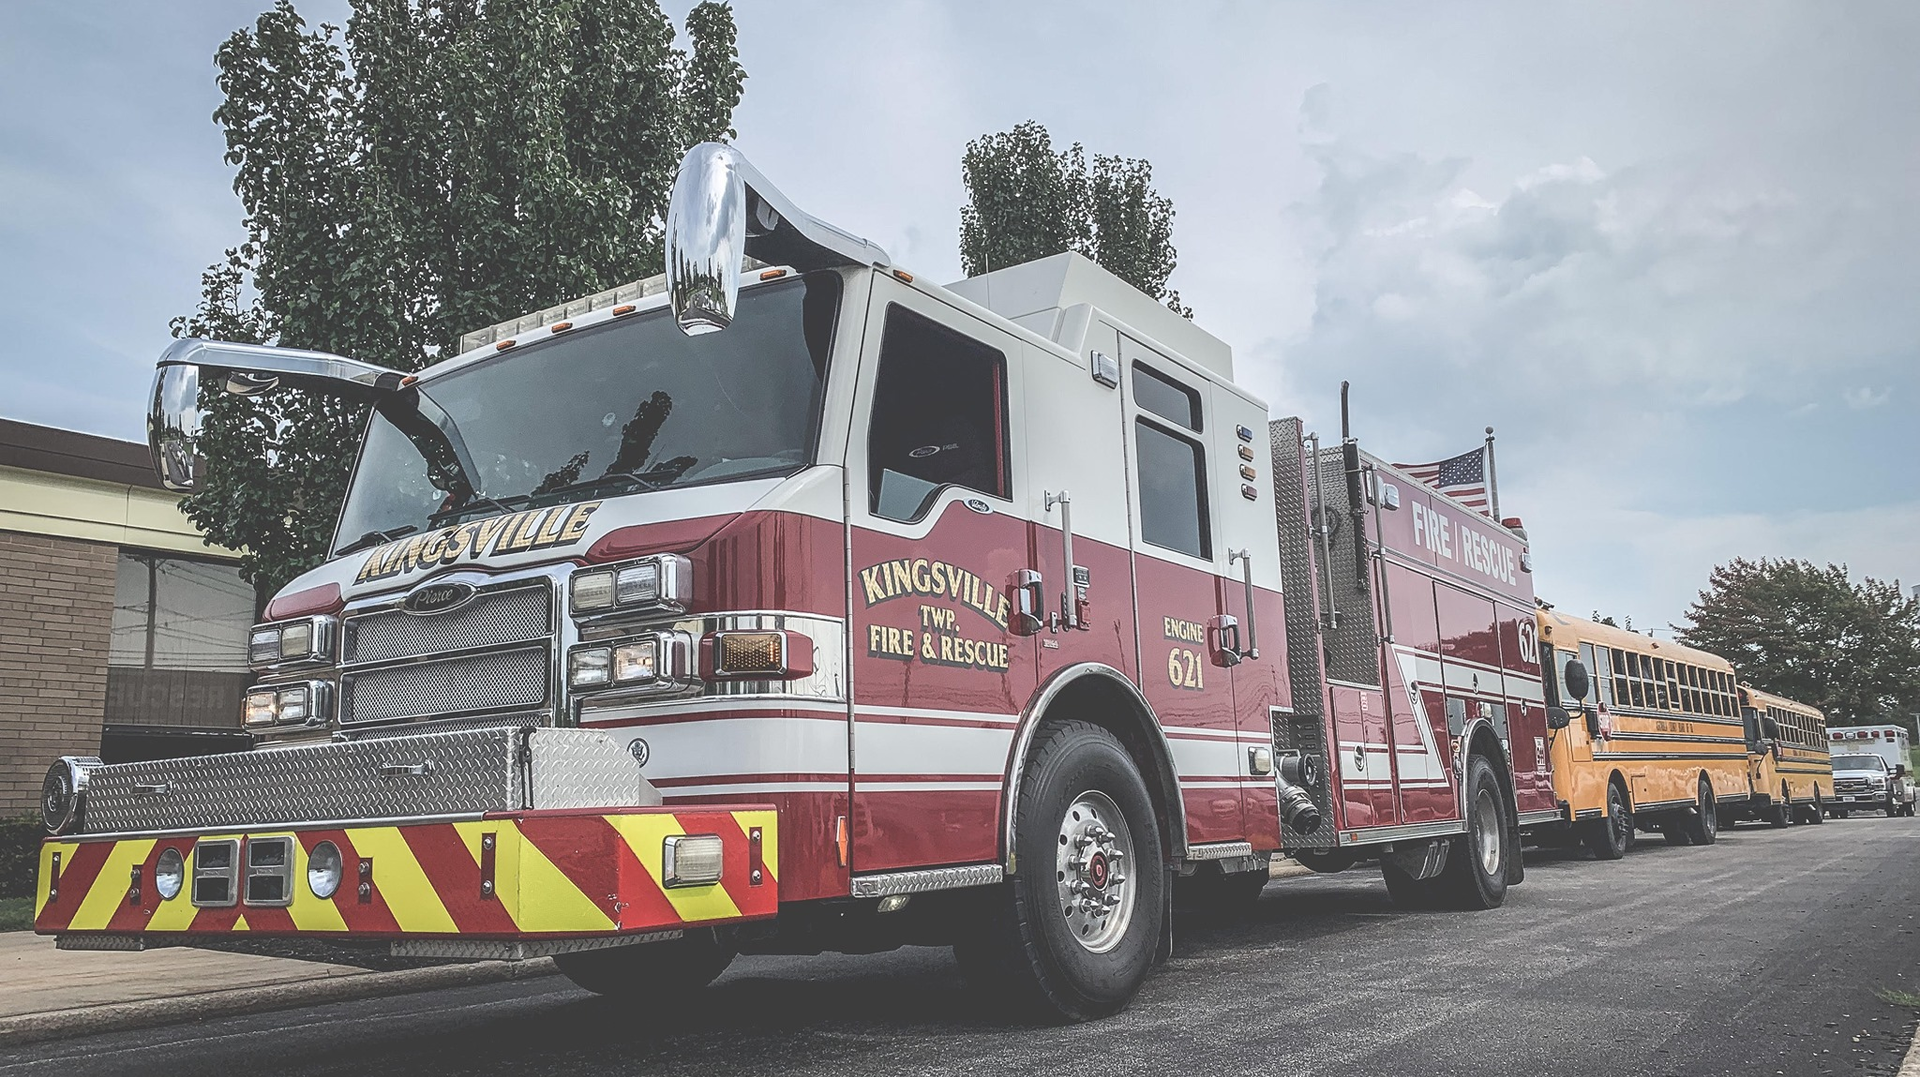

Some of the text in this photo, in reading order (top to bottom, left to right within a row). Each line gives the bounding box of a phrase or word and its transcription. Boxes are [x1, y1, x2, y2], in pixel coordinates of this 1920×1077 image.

[354, 501, 601, 585] KINGSVILLE
[1411, 500, 1452, 560] FIRE
[1461, 525, 1517, 587] RESCUE
[415, 588, 454, 606] Pierce
[858, 558, 1011, 632] KINGSVILLE
[919, 604, 961, 634] TWP.
[1163, 616, 1204, 645] ENGINE
[867, 624, 1009, 673] FIRE & RESCUE
[1168, 647, 1204, 691] 621
